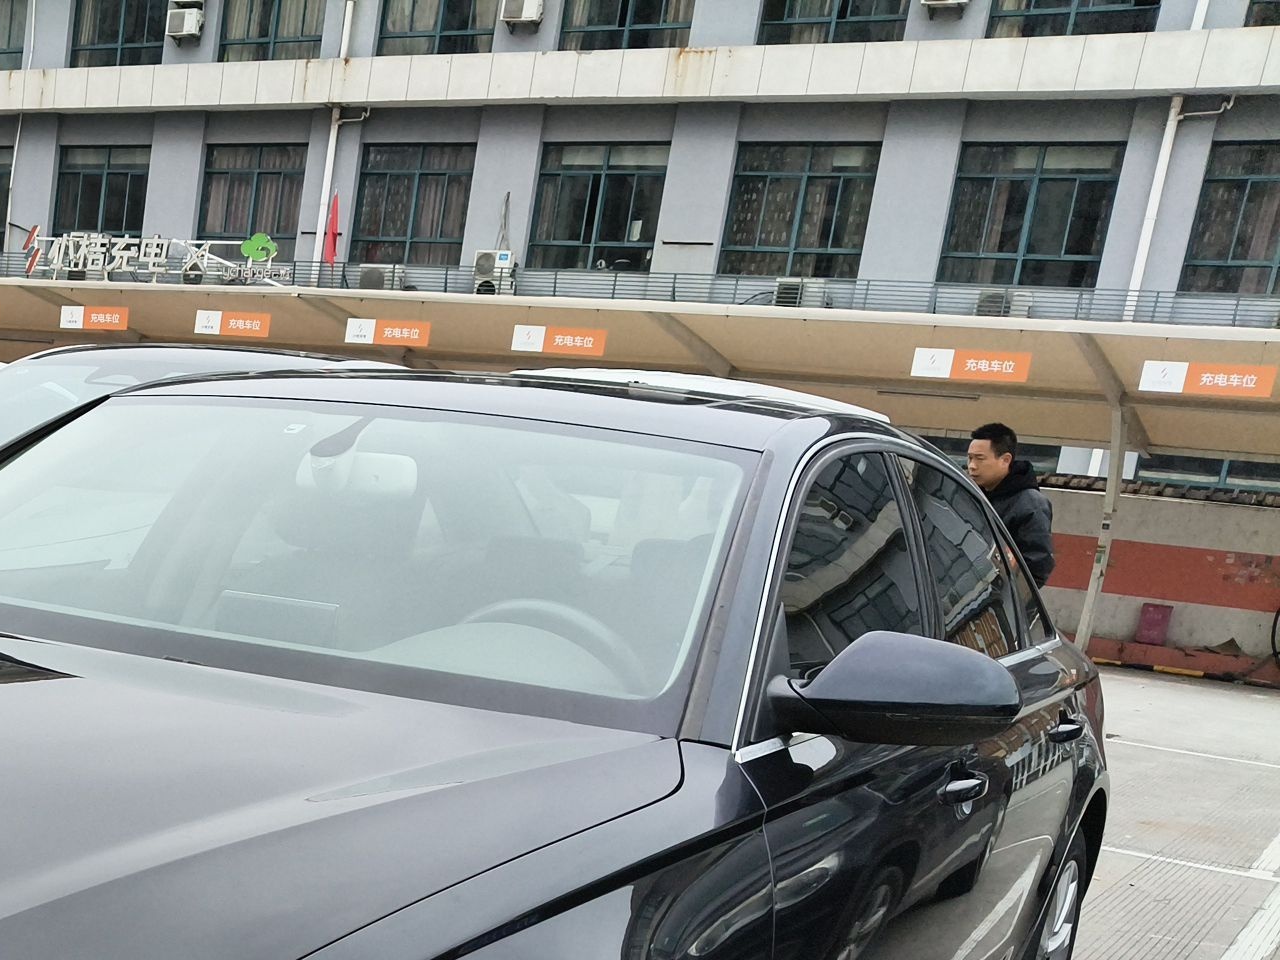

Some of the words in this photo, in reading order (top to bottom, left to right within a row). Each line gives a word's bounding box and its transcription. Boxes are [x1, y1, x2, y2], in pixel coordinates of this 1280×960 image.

[48, 232, 169, 273] 小桔充电
[90, 313, 120, 324] 充电车位
[228, 318, 262, 331] 充电车位
[383, 327, 420, 339] 充电车位
[553, 335, 595, 348] 充电车位
[964, 359, 1016, 373] 充电车位
[1200, 373, 1258, 388] 充电车位
